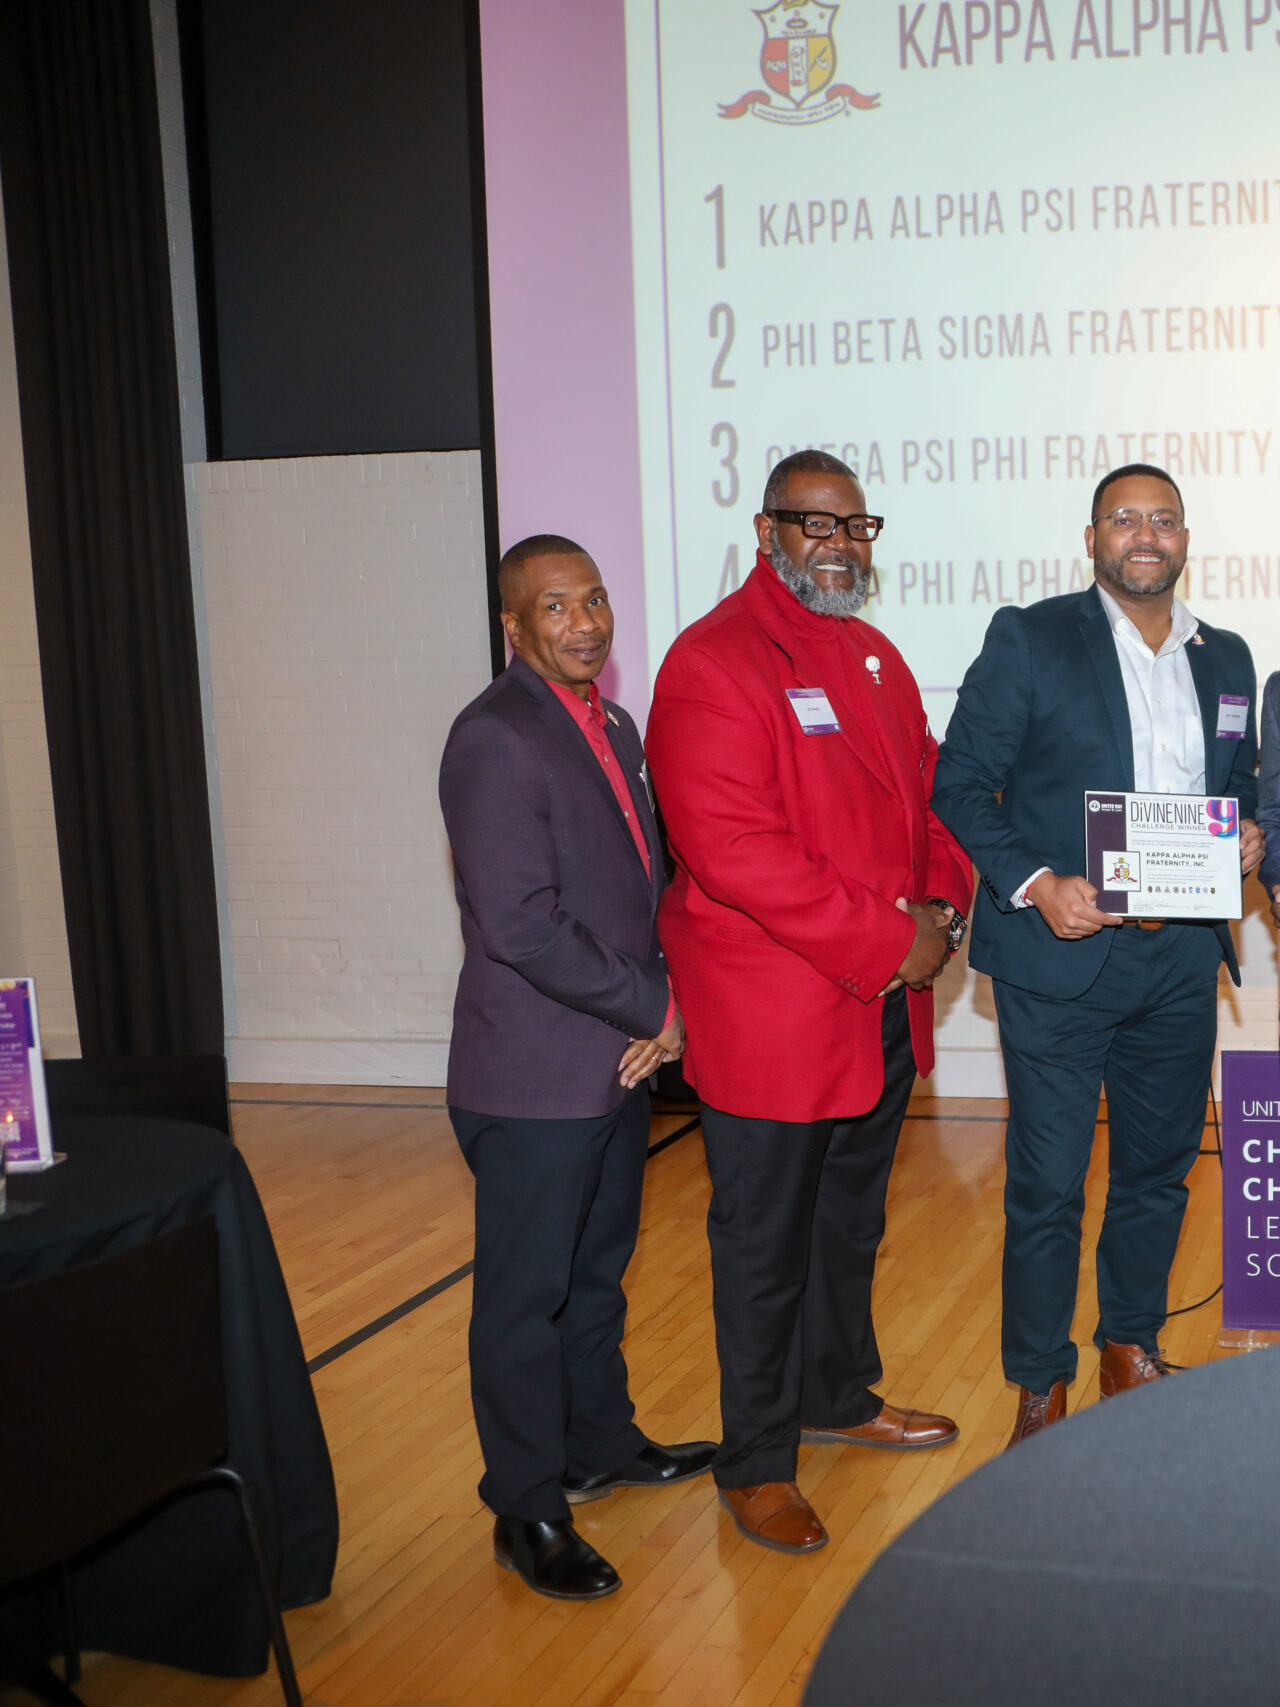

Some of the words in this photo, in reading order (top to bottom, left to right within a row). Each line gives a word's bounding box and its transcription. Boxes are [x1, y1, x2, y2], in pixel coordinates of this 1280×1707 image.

[900, 1, 1055, 69] KAPPA
[1070, 0, 1228, 60] ALPHA
[703, 183, 727, 270] 1
[758, 196, 874, 248] KAPPA
[890, 190, 1005, 240] ALPHA
[1021, 187, 1076, 234] PSI
[708, 302, 737, 389] 2
[762, 321, 817, 368] PHI
[833, 317, 923, 366] BETA
[938, 311, 1052, 360] SIGMA
[709, 420, 741, 509] 3
[901, 437, 957, 486] PSI
[971, 434, 1029, 483] PHI
[899, 559, 954, 607] PHI
[970, 554, 1088, 606] ALPHA
[1131, 823, 1175, 831] CHALLENGE
[1177, 824, 1207, 832] WINNER
[1146, 859, 1192, 867] FRATERNITY,
